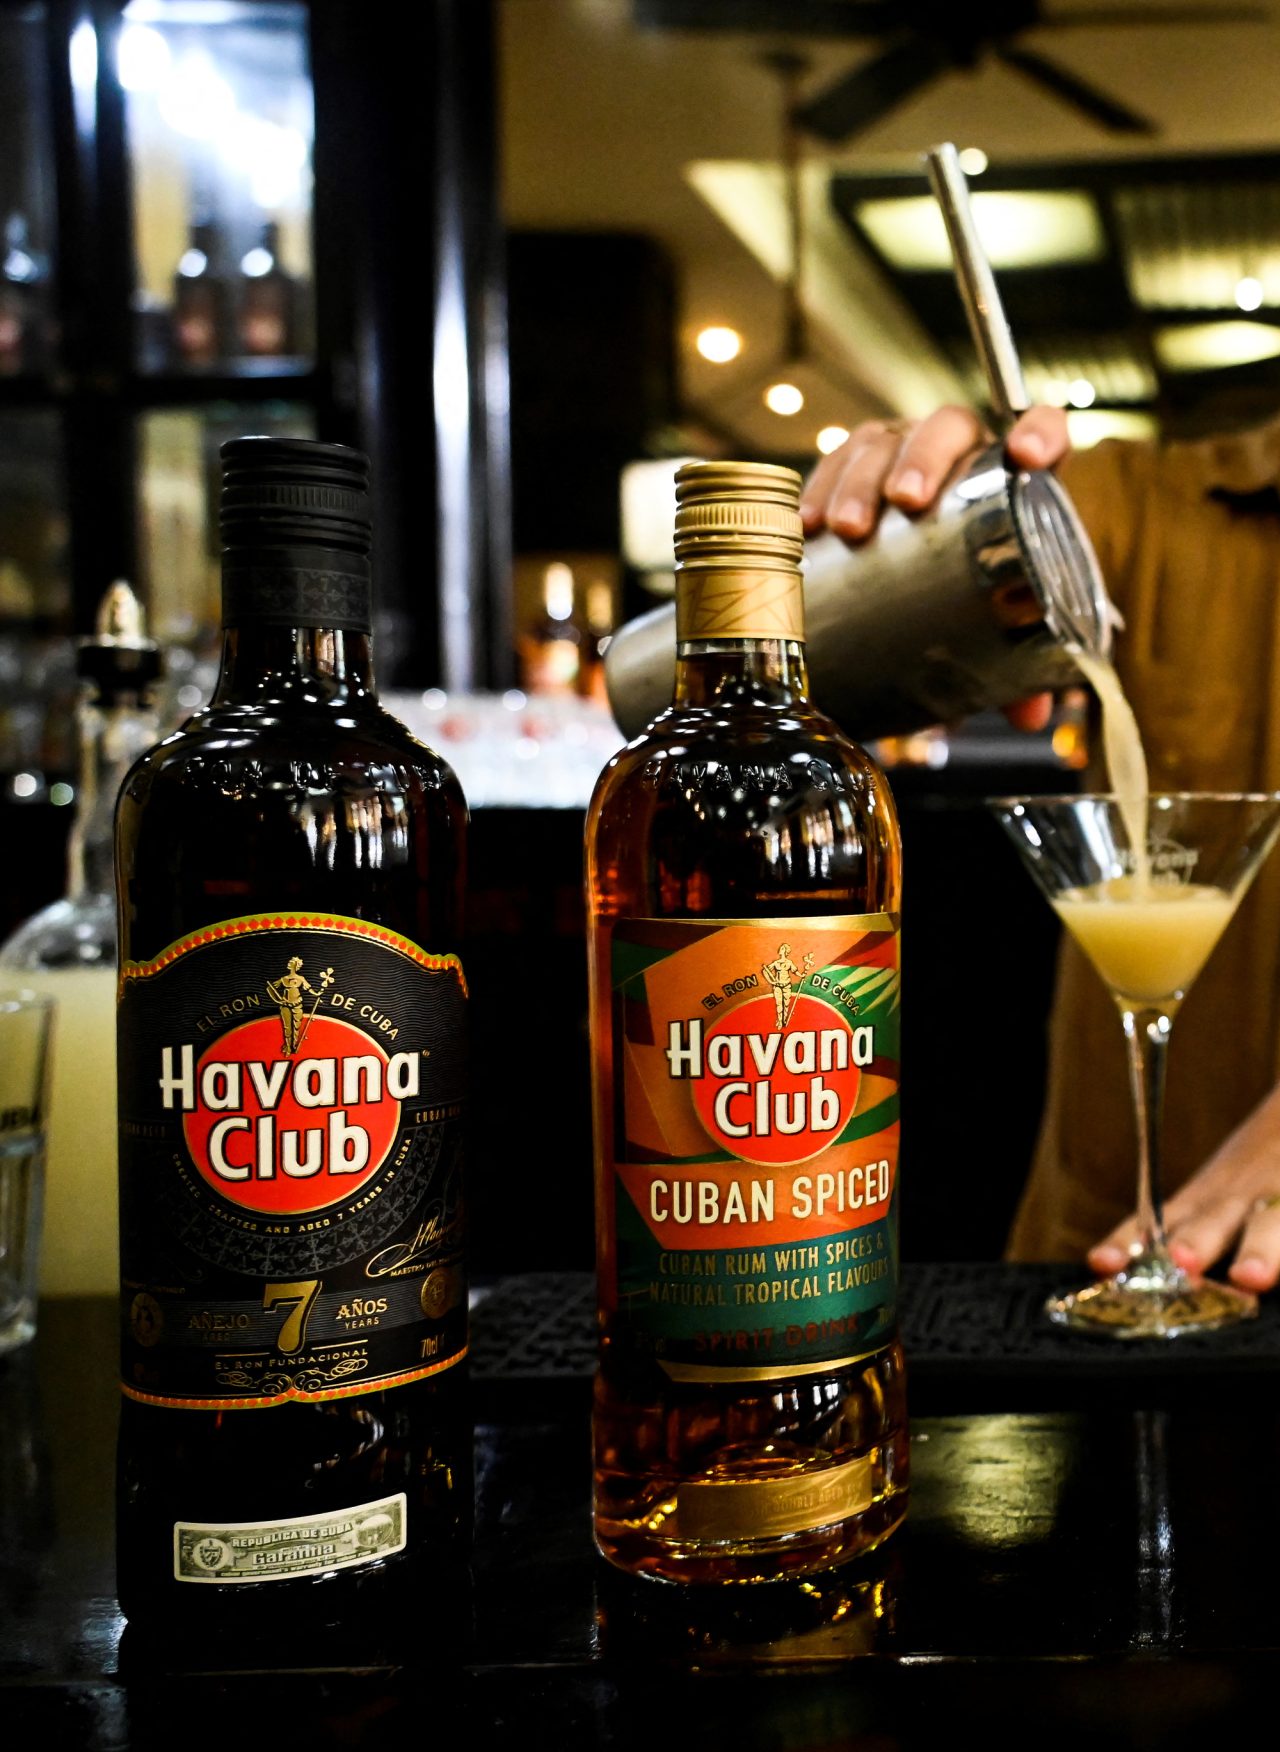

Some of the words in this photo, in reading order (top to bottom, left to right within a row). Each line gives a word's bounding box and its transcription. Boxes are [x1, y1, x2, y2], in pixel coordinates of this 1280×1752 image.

[196, 1015, 218, 1032] EL
[219, 993, 261, 1017] RON
[331, 993, 357, 1011] DE
[360, 1005, 399, 1041] CUBA
[702, 993, 723, 1011] EL
[723, 975, 759, 997] RON
[811, 974, 829, 991] DE
[831, 983, 861, 1016] CUBA
[667, 1018, 875, 1078] Havana
[159, 1044, 421, 1110] Havana
[715, 1076, 841, 1138] Club
[208, 1110, 370, 1181] Club
[264, 1225, 291, 1234] AND
[298, 1218, 331, 1233] AGED
[348, 1185, 384, 1213] YEARS
[384, 1170, 396, 1183] IN
[395, 1138, 412, 1166] CUBA
[650, 1179, 775, 1224] CUBAN
[791, 1159, 890, 1219] SPICED
[659, 1252, 717, 1276] CUBAN
[725, 1252, 767, 1275] RUM
[774, 1246, 819, 1271] WITH
[826, 1233, 873, 1265] SPICES
[876, 1232, 884, 1248] &
[651, 1281, 726, 1306] NATURAL
[735, 1276, 821, 1305] TROPICAL
[828, 1258, 889, 1294] FLAVOURS
[188, 1311, 250, 1329] AÑEJO
[263, 1280, 323, 1356] 7
[335, 1297, 388, 1321] AÑOS
[345, 1317, 380, 1331] YEARS
[694, 1327, 774, 1352] SPIRIT
[786, 1313, 859, 1347] DRINK
[215, 1361, 229, 1371] EL
[235, 1360, 263, 1371] RON
[269, 1348, 368, 1367] FUNDACIONAL
[232, 1531, 300, 1548] REPUBLICA
[302, 1528, 319, 1539] DE
[320, 1522, 354, 1537] CUBA
